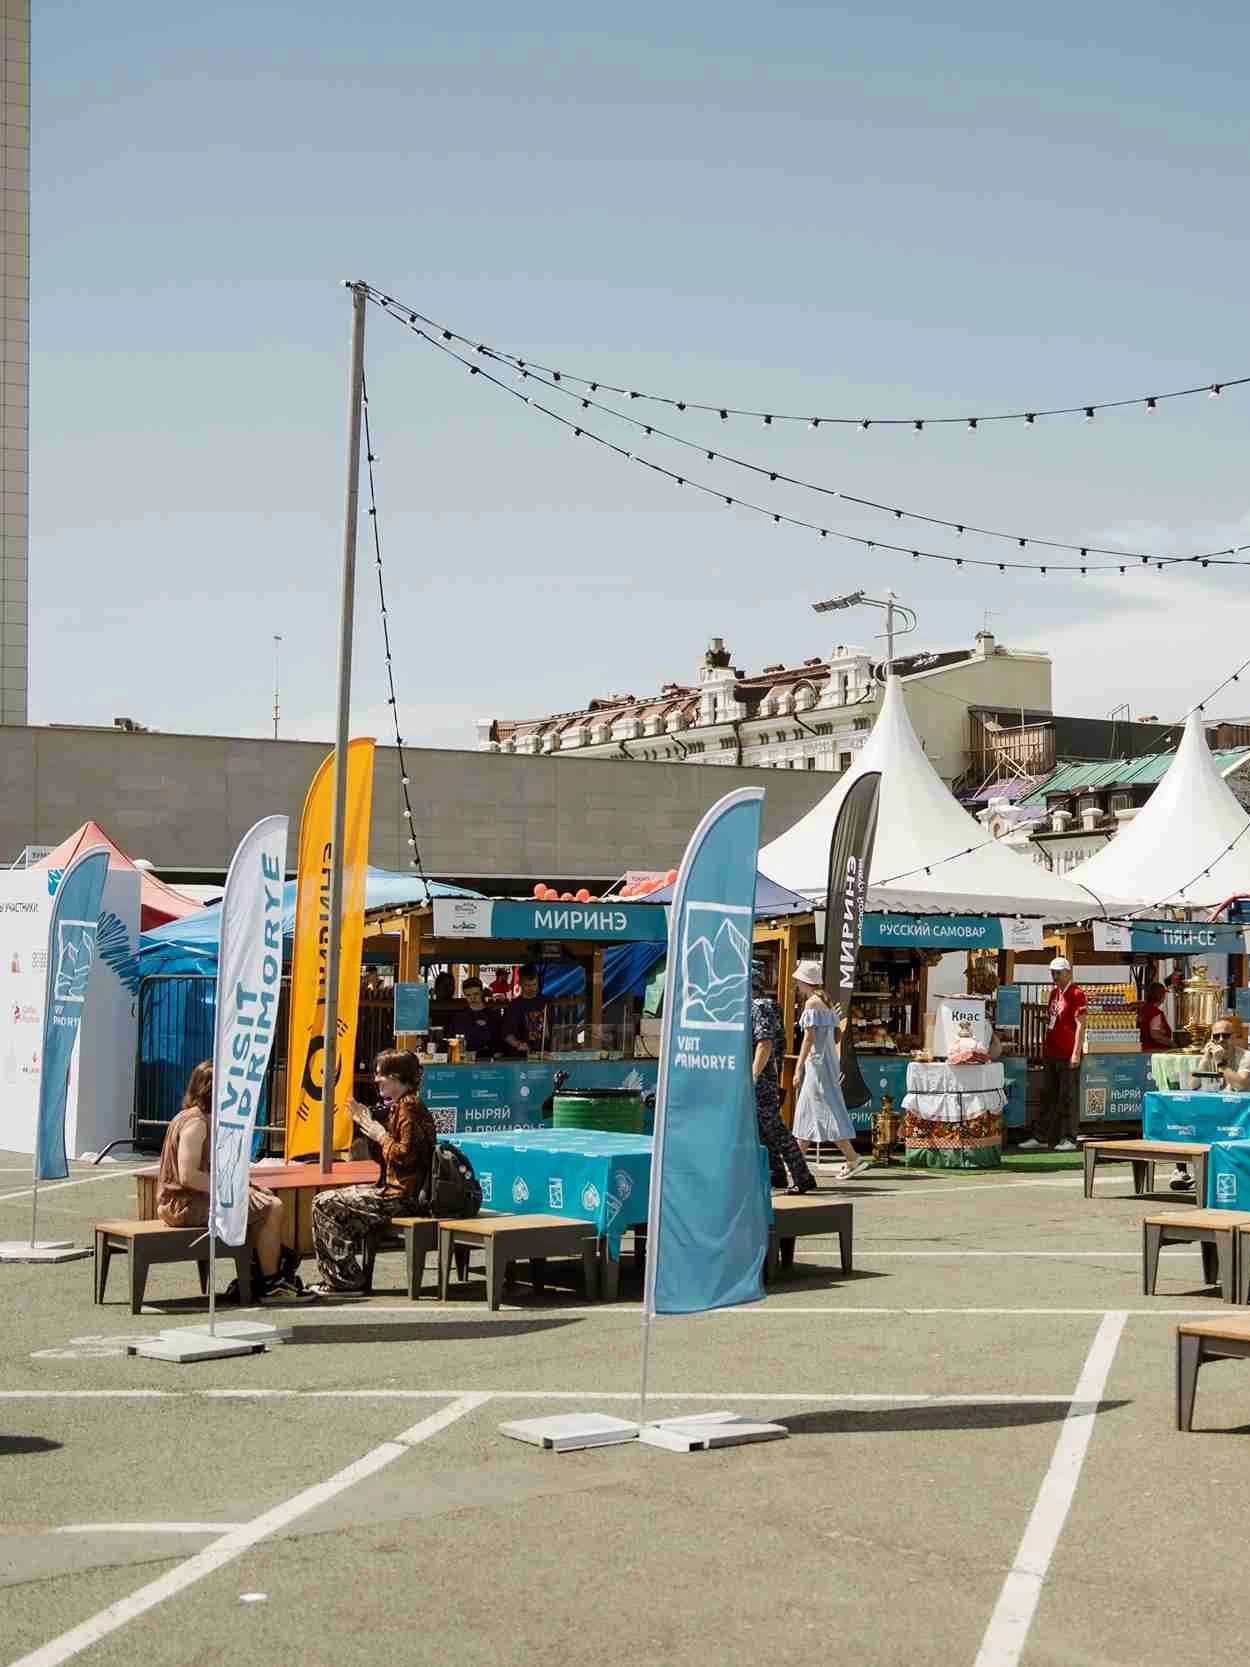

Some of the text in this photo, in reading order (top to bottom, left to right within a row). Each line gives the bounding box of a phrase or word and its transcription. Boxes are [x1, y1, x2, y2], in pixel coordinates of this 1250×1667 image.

[534, 910, 628, 930] МИРИНЭ
[839, 855, 857, 989] МИРИНЭ
[879, 922, 986, 937] РУССКИЙ САМОВАР
[237, 851, 281, 1117] PRIMORYE
[220, 981, 258, 1113] VISIT
[674, 1053, 736, 1070] PRIMORYE
[1110, 1088, 1142, 1100] НЫРЯЙ
[465, 1105, 511, 1120] НЫРЯЙ
